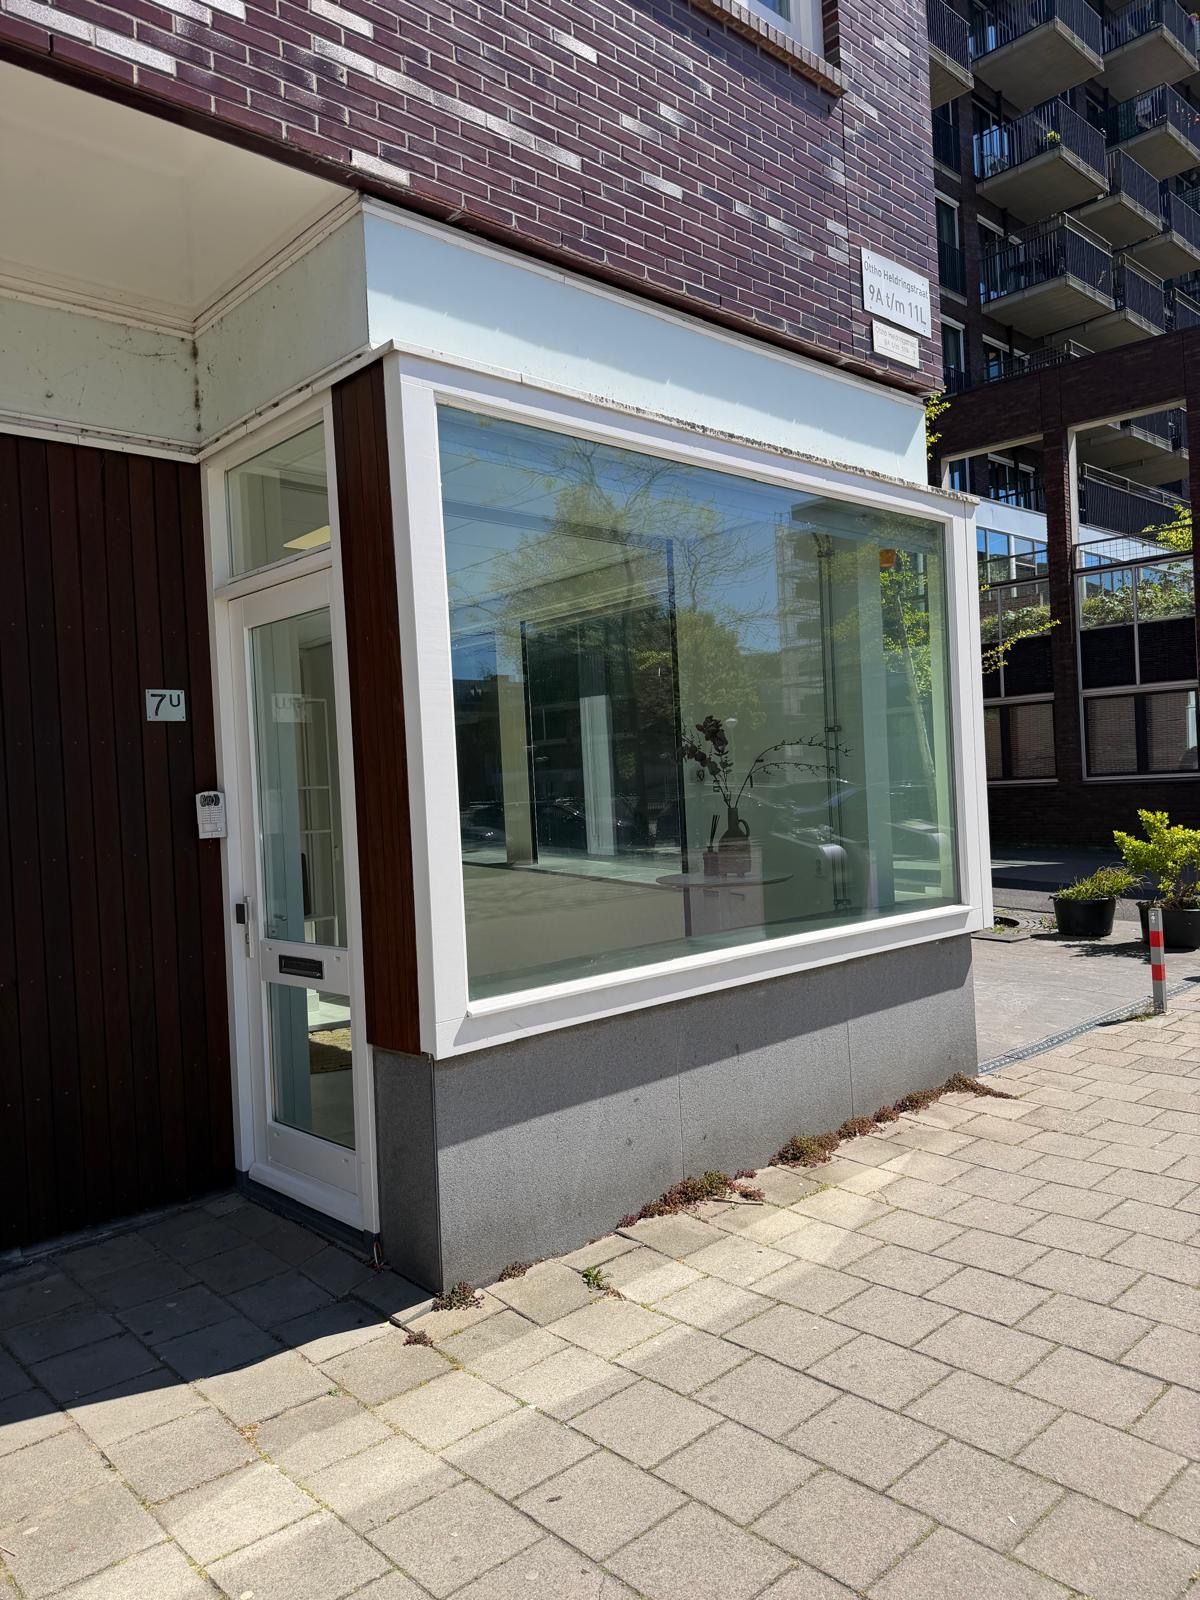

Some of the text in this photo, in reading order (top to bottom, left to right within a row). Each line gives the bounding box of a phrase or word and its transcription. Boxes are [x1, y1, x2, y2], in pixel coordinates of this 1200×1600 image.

[864, 261, 928, 299] Ottho Heldringstraat
[869, 284, 926, 325] 9A t/m 11L
